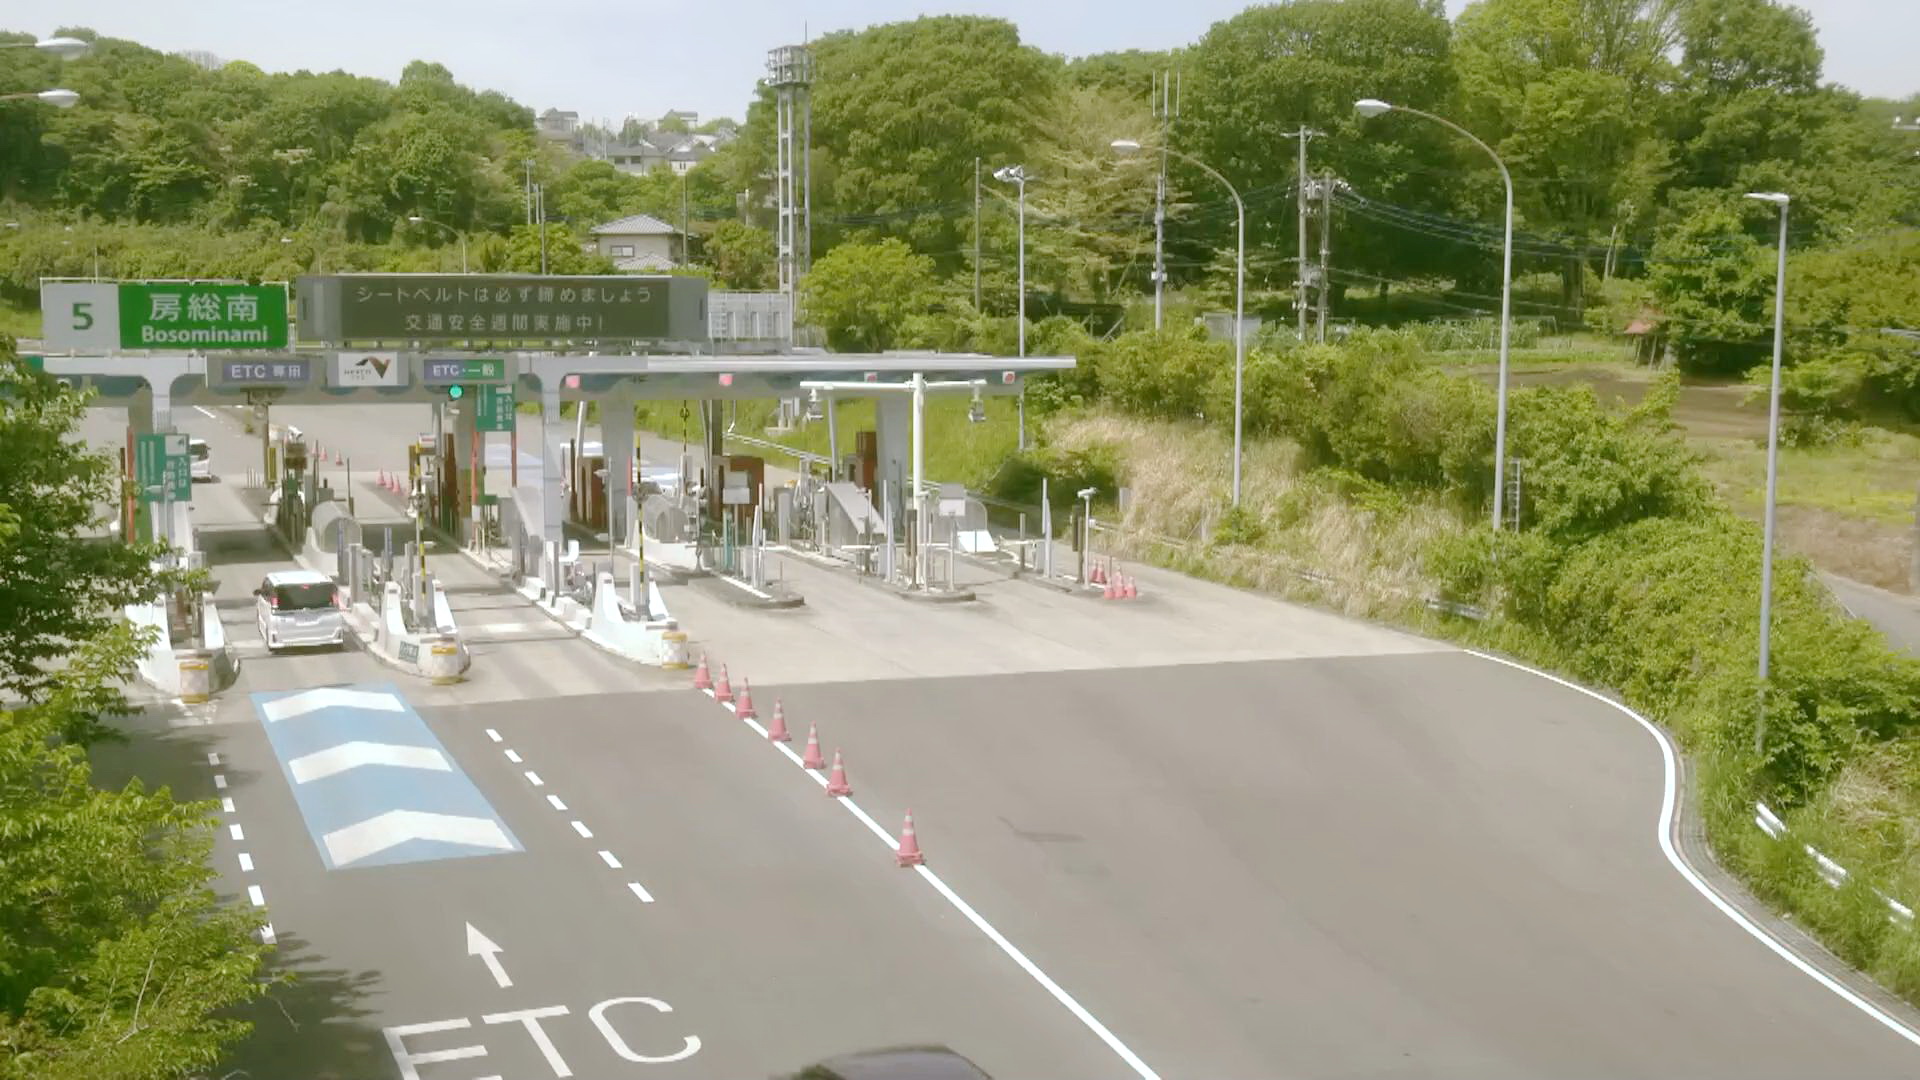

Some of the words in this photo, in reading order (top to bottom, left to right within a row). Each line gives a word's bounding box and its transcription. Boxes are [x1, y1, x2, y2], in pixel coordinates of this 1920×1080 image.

[357, 286, 651, 303] シートベルトは必ず締めましょう
[72, 302, 94, 330] 5
[149, 293, 258, 322] 房総南
[141, 325, 268, 343] Bosominami
[231, 364, 265, 378] ETC
[382, 996, 701, 1080] ETC
